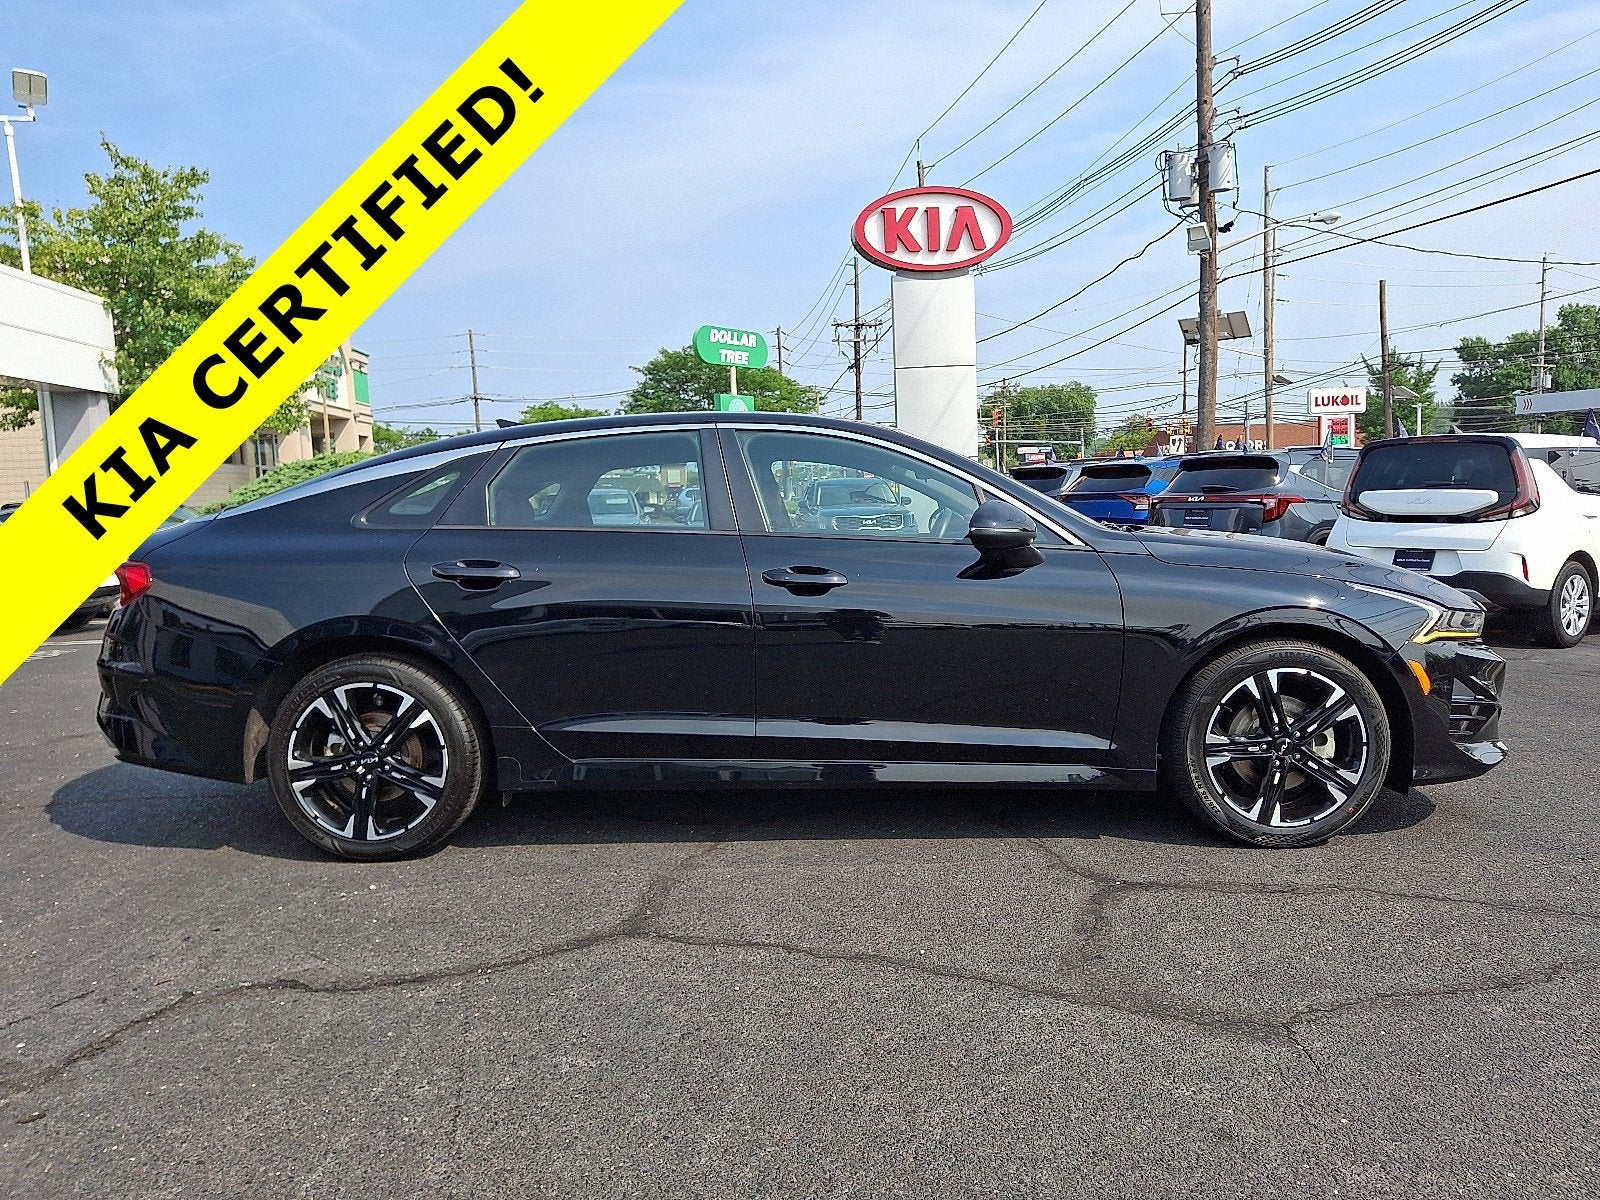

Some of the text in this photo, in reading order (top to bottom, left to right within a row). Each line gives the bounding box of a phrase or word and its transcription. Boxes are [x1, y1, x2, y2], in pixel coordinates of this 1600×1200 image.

[881, 206, 987, 253] KIA
[709, 328, 757, 348] DOLLAR
[718, 349, 750, 365] TREE
[1314, 394, 1361, 408] LUKOIL
